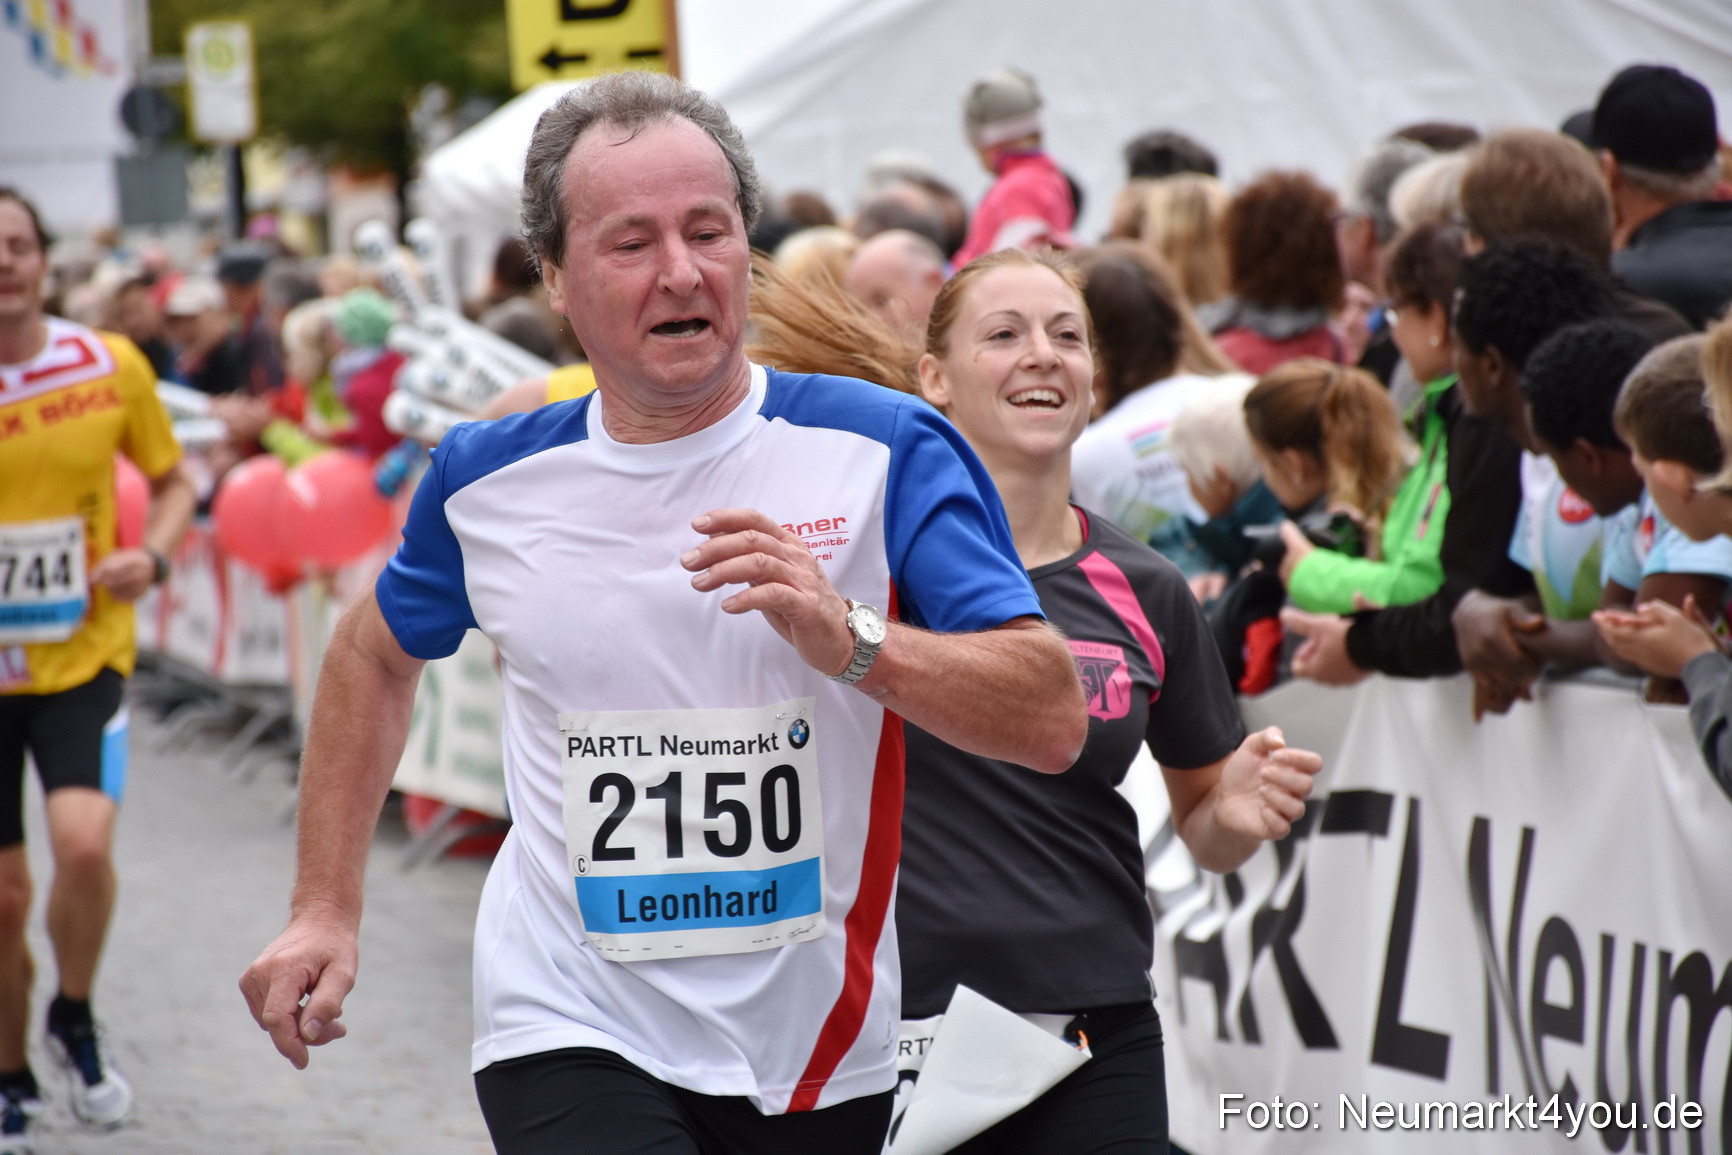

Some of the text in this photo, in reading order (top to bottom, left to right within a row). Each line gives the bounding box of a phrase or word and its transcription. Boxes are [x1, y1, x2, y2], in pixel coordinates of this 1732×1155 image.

[567, 732, 780, 758] PARTL Neumarkt
[589, 764, 802, 862] 2150
[617, 880, 778, 923] Leonhard
